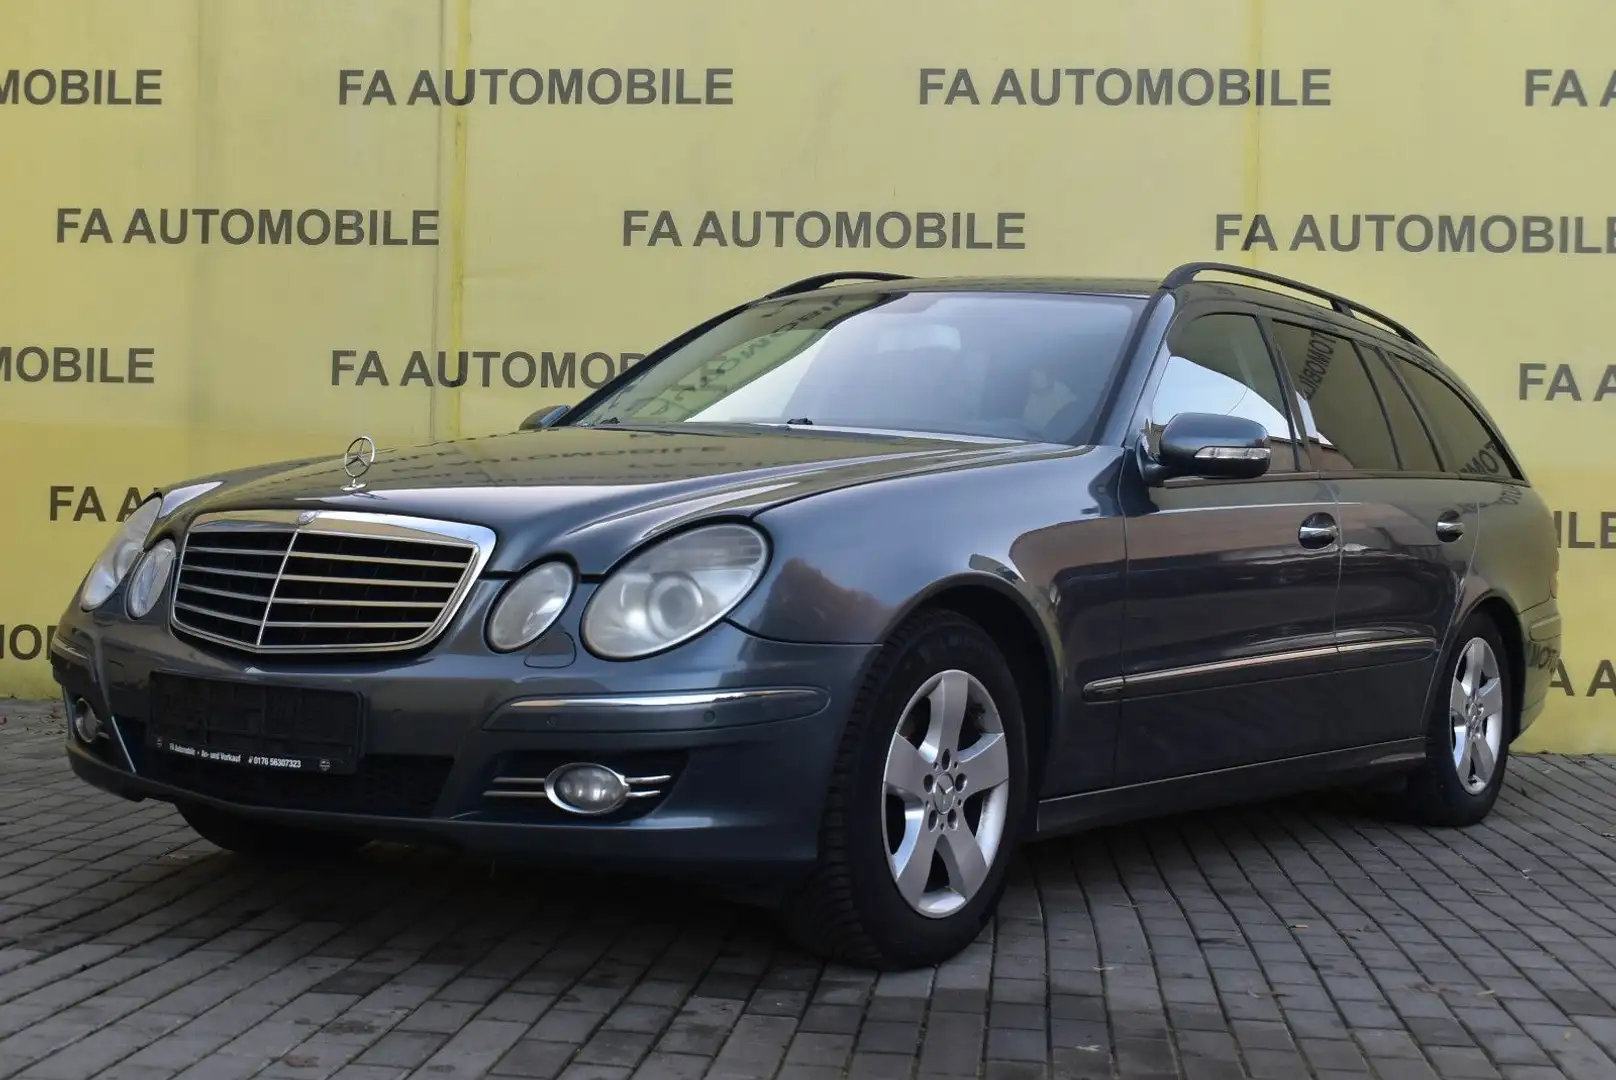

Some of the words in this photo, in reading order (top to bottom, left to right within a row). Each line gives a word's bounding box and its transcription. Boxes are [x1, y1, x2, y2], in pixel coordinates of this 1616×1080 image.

[339, 69, 397, 106] FA
[407, 68, 734, 106] AUTOMOBILE
[919, 68, 980, 106] FA
[991, 68, 1331, 106] AUTOMOBILE
[1525, 69, 1588, 107] FA
[56, 208, 113, 244] FA
[122, 208, 439, 246] AUTOMOBILE
[623, 210, 683, 247] FA
[692, 210, 1026, 250] AUTOMOBILE
[1216, 214, 1278, 252] FA
[331, 349, 389, 386] FA
[1519, 363, 1582, 402] FA
[49, 485, 107, 522] FA
[116, 486, 158, 522] A
